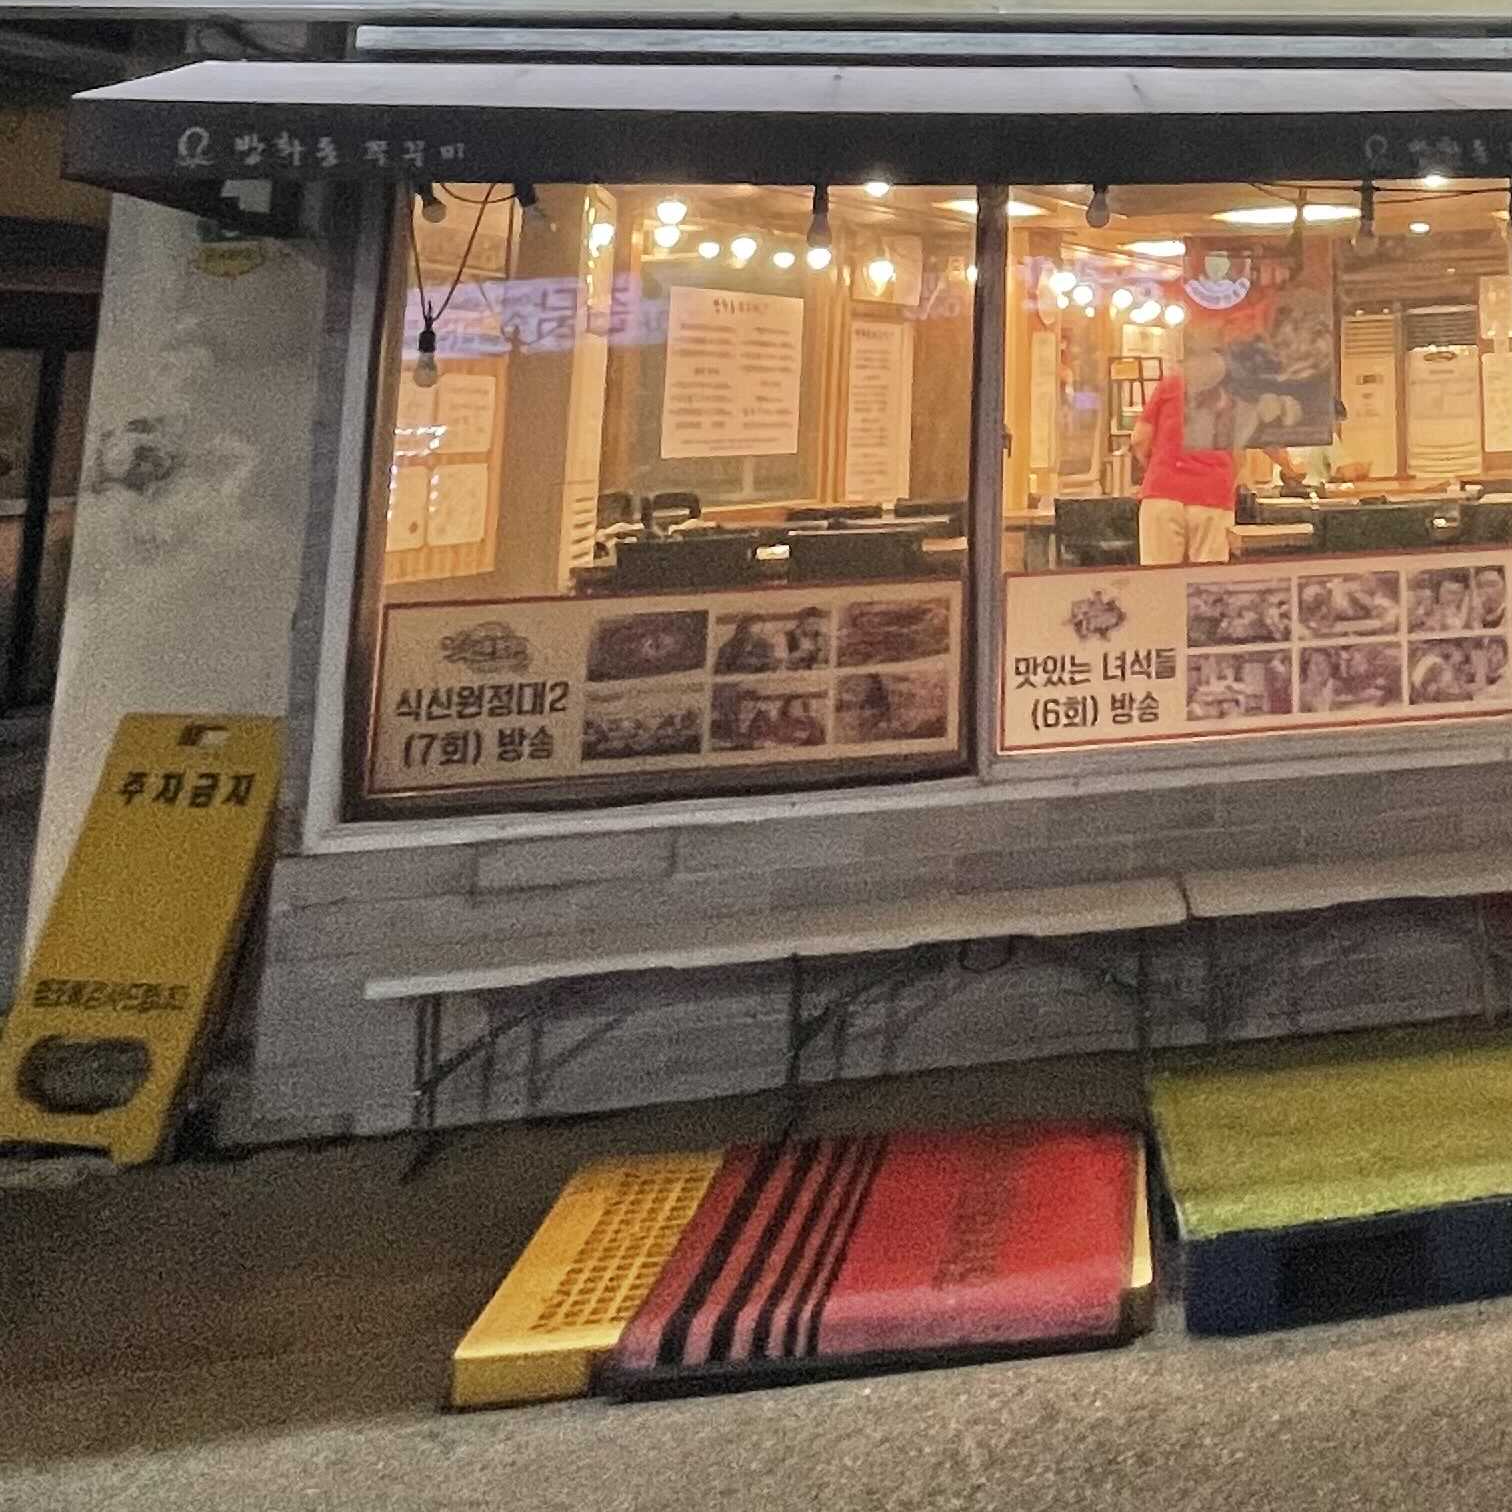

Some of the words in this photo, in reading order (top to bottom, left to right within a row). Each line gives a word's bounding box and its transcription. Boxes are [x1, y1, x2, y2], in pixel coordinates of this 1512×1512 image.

[1013, 651, 1093, 689] 맛있는
[1101, 648, 1177, 682] 녀석들
[395, 679, 570, 724] 식신원정대2
[1031, 694, 1099, 731] (6회)
[1109, 689, 1161, 724] 방송
[403, 727, 484, 769] (7회)
[496, 725, 555, 763] 방송
